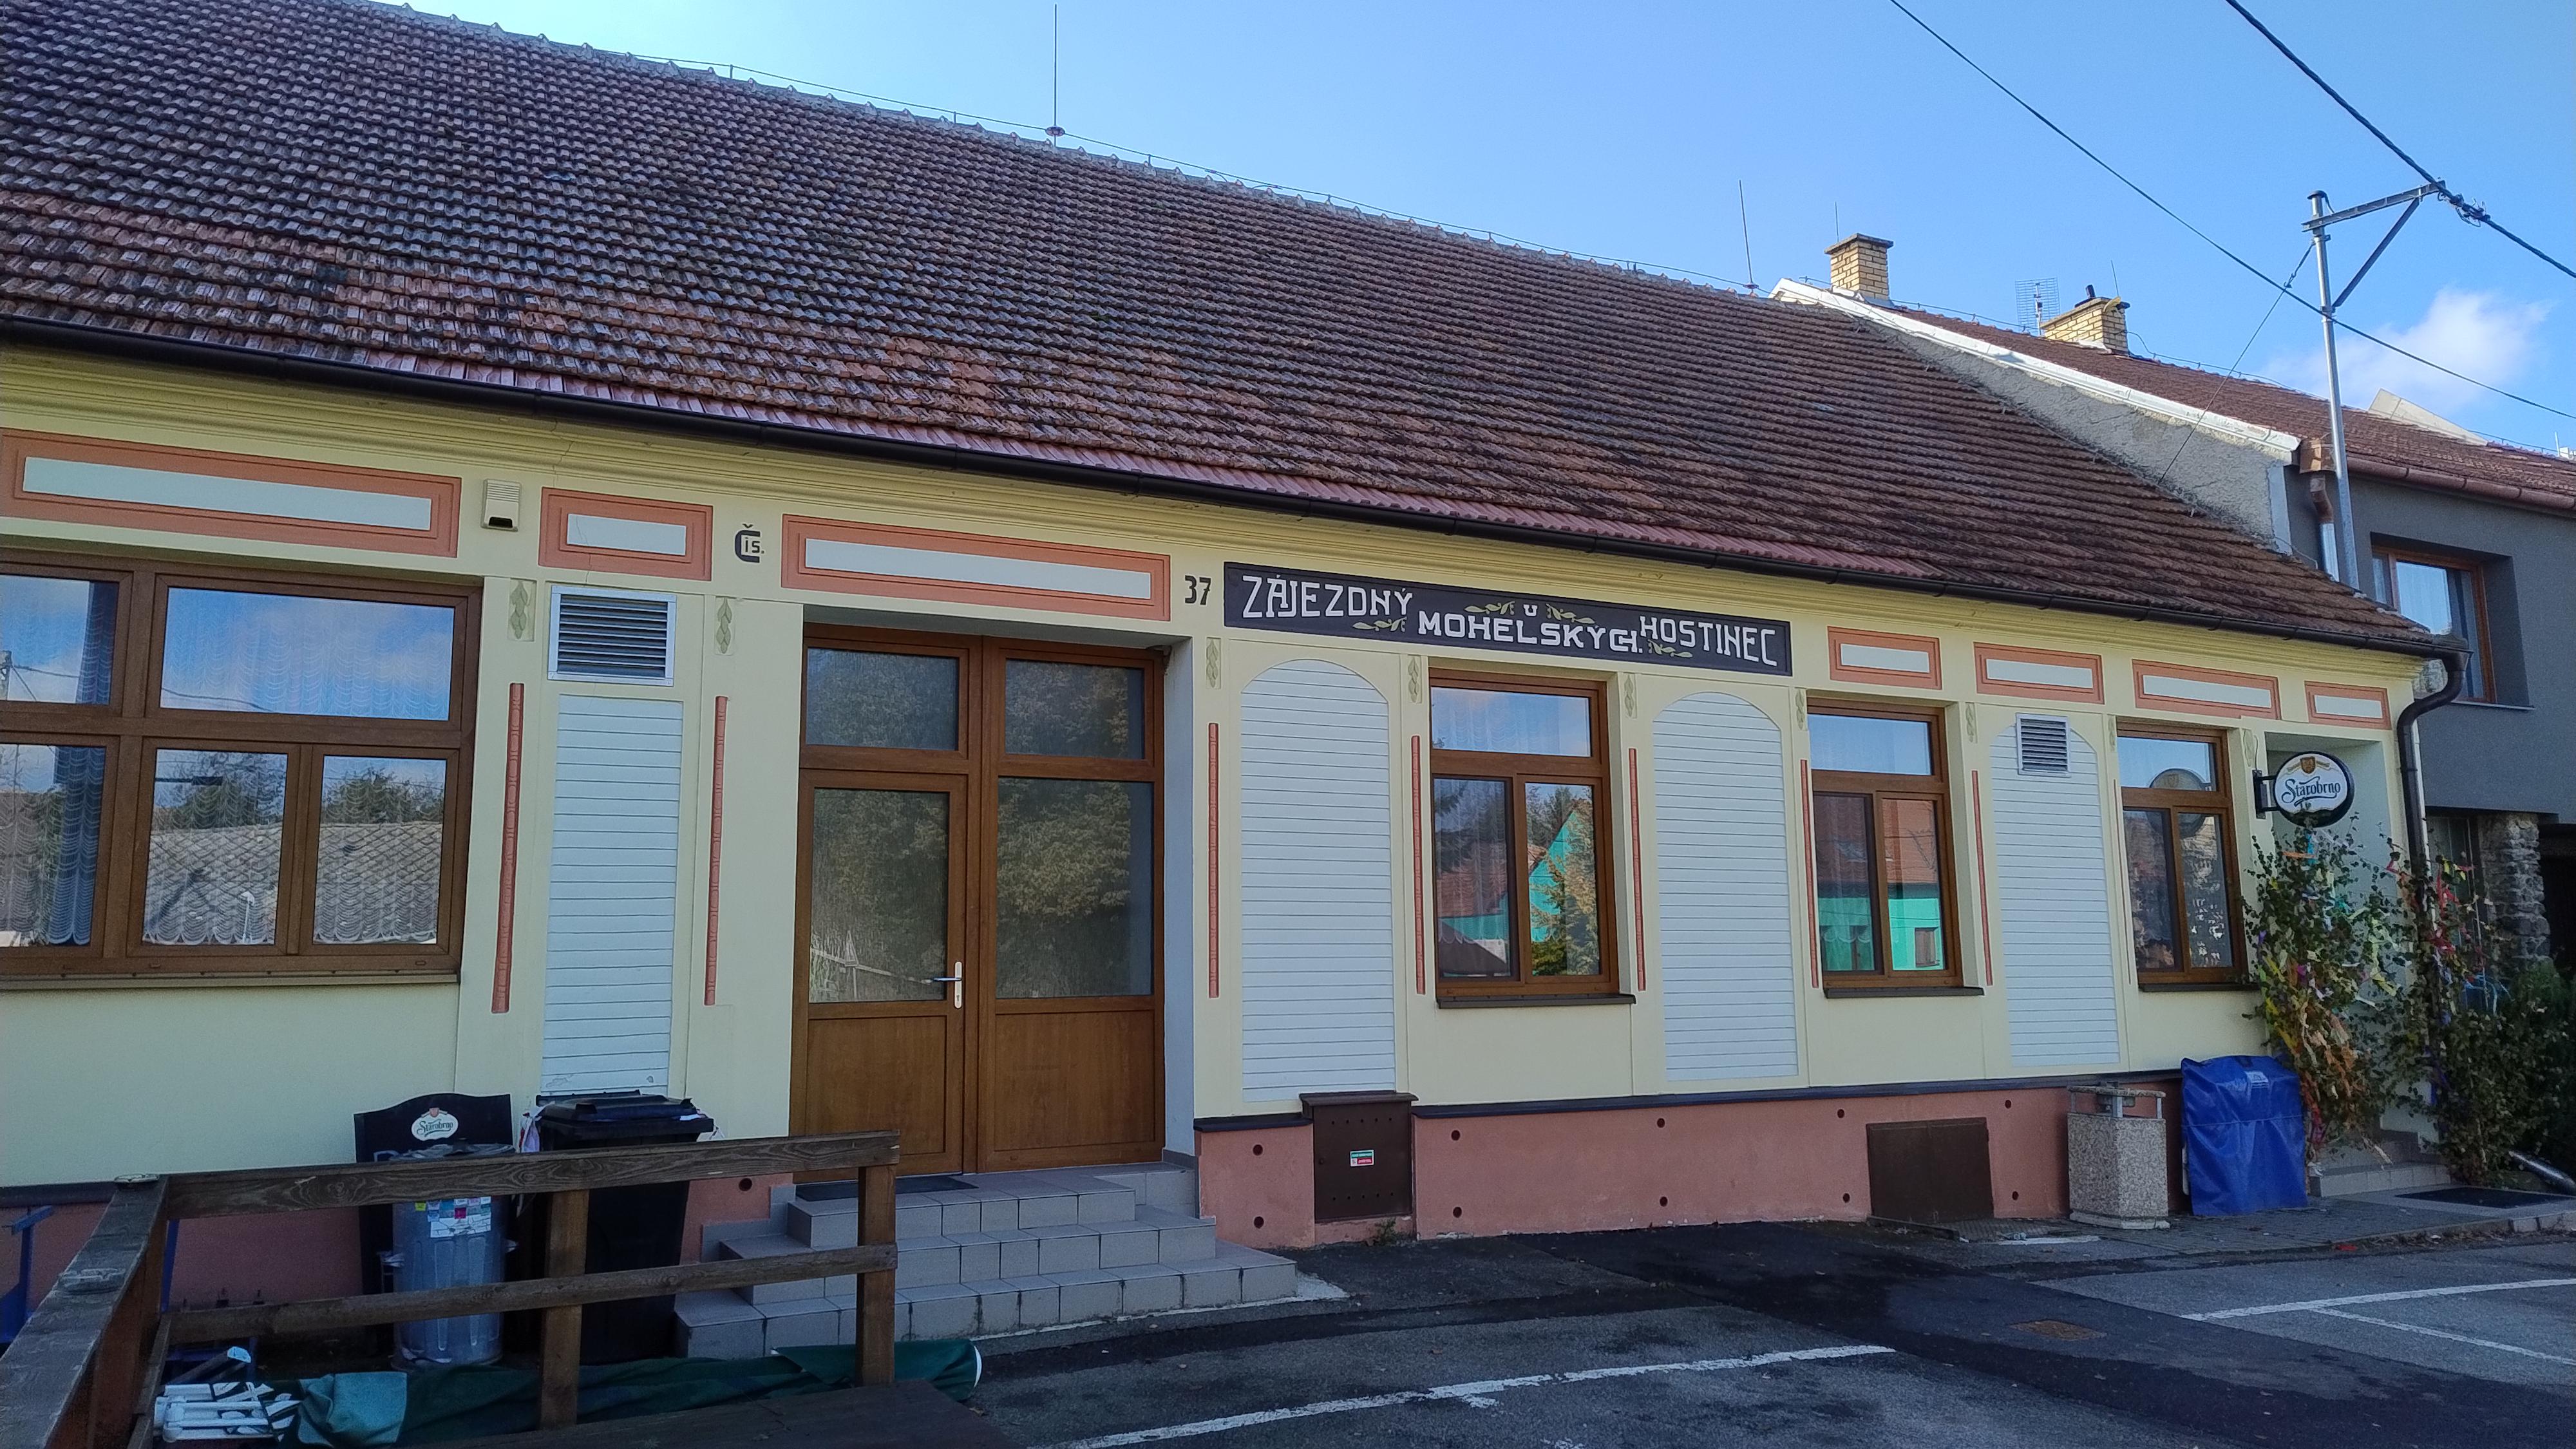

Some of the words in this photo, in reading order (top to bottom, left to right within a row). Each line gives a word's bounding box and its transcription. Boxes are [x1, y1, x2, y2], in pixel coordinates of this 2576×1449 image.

[1184, 575, 1211, 605] 37
[1242, 574, 1413, 619] ZÁJEZDNÝ
[1522, 604, 1539, 617] U
[1639, 616, 1777, 667] HOSTINEC
[2281, 776, 2341, 807] Starobrno
[416, 1119, 454, 1137] Starobrno
